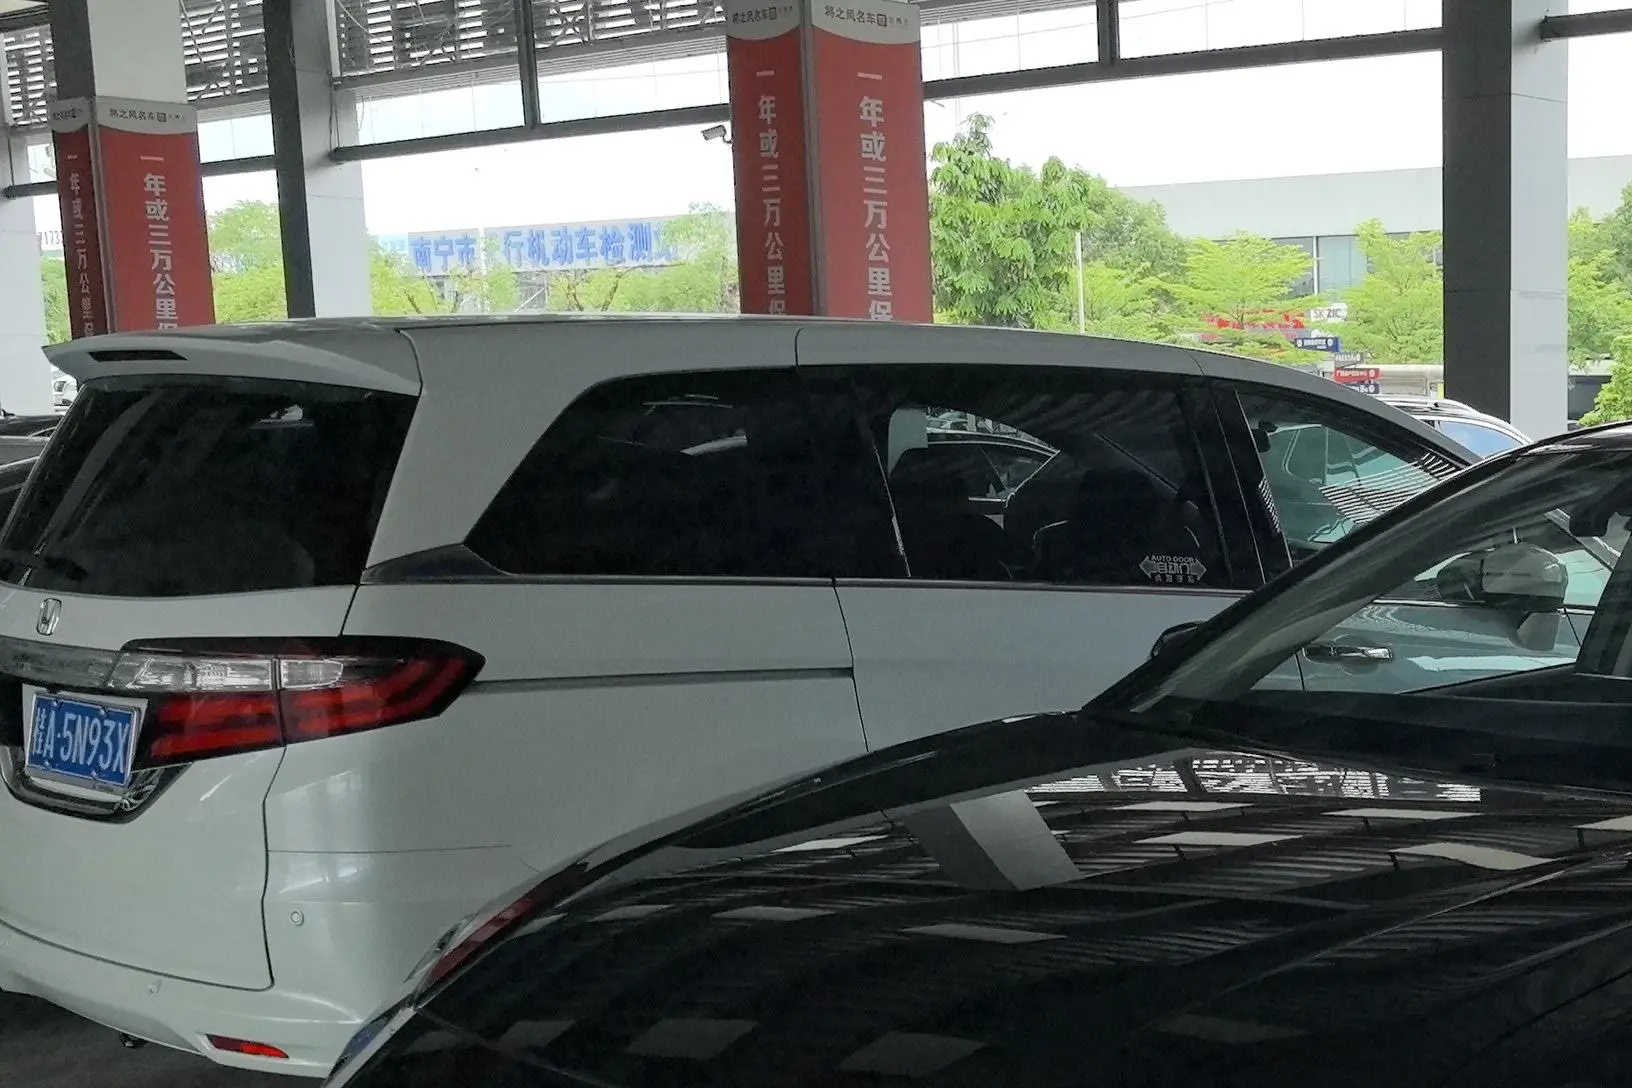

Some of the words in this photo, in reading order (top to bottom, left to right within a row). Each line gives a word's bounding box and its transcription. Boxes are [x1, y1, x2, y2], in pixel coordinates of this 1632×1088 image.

[140, 155, 178, 329] 一年或三万公里
[1157, 561, 1190, 575] 自动门
